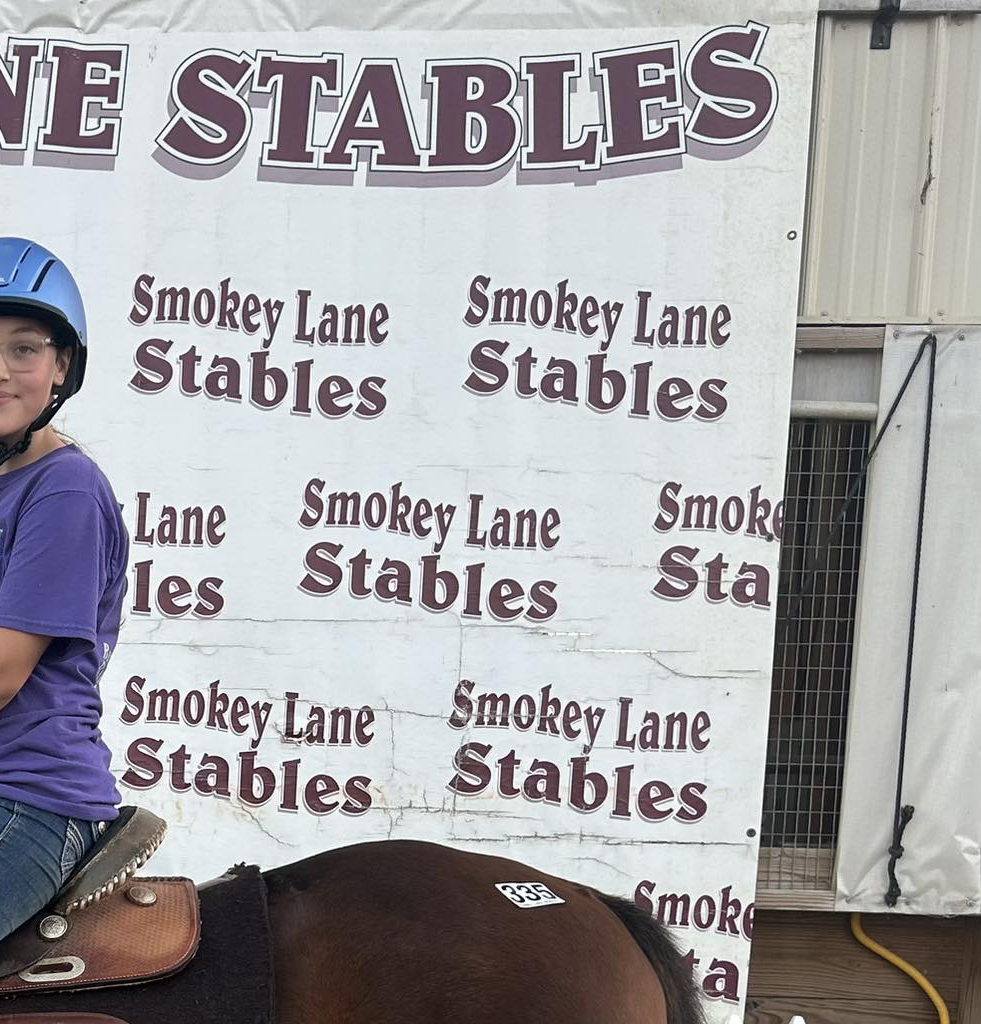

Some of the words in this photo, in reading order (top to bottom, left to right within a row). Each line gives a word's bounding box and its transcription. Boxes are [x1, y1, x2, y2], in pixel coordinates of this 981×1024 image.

[154, 20, 778, 175] STABLES
[129, 274, 284, 348] Smokey
[295, 289, 389, 344] Lane
[464, 275, 624, 350] Smokey
[634, 291, 731, 346] Lane
[129, 339, 388, 417] Stables
[463, 340, 731, 419] Stables
[134, 492, 226, 546] Lane
[299, 478, 457, 551] Smokey
[466, 494, 561, 548] Lane
[653, 481, 783, 540] Smoke
[299, 543, 559, 621] Stables
[120, 675, 274, 742] Smokey
[284, 691, 375, 745] Lane
[448, 680, 605, 752] Smokey
[616, 698, 711, 751] Lane
[120, 737, 374, 817] Stables
[448, 742, 710, 822] Stables
[501, 884, 557, 904] 335
